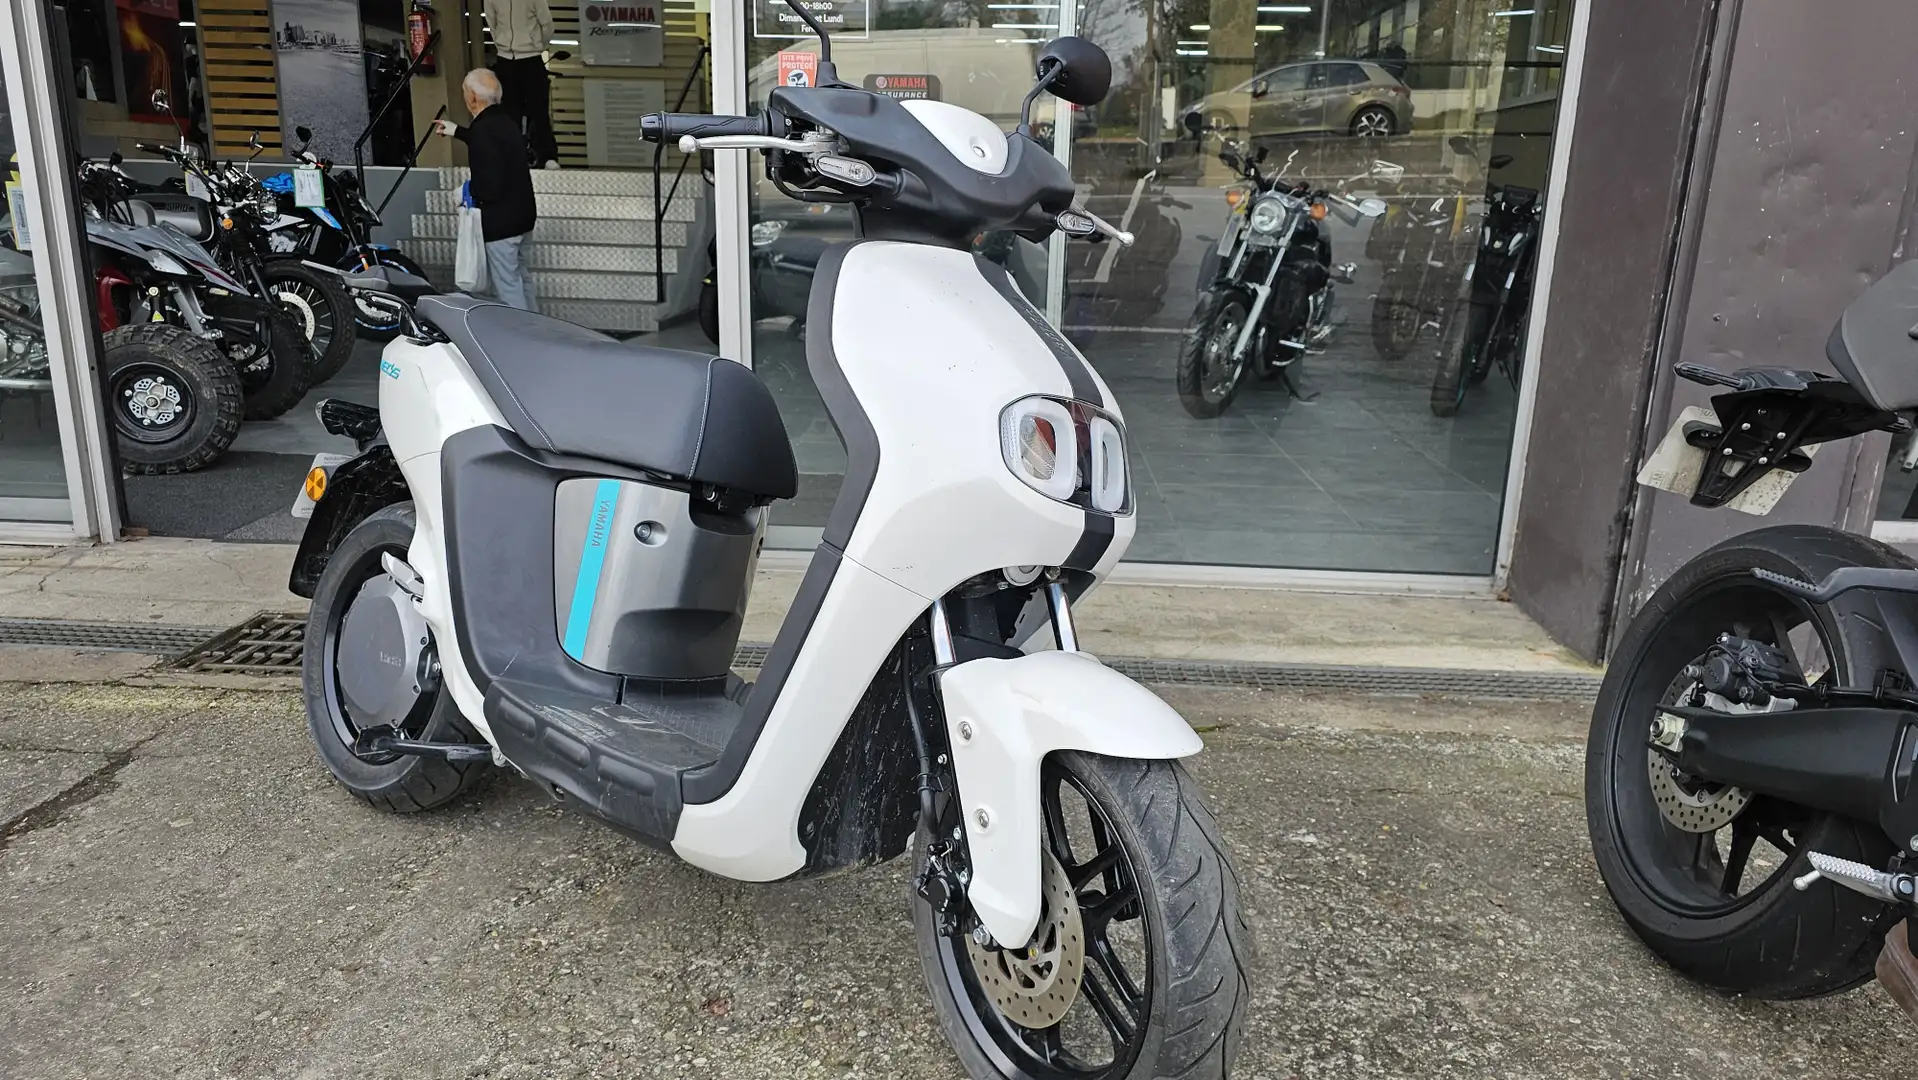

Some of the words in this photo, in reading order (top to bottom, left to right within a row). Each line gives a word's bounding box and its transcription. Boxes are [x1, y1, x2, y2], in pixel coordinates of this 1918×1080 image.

[601, 6, 656, 22] YAMAHA
[823, 13, 844, 23] Lundi
[887, 76, 927, 89] YAMAHA
[877, 91, 928, 99] SURANCE
[591, 500, 611, 547] YAMAHA
